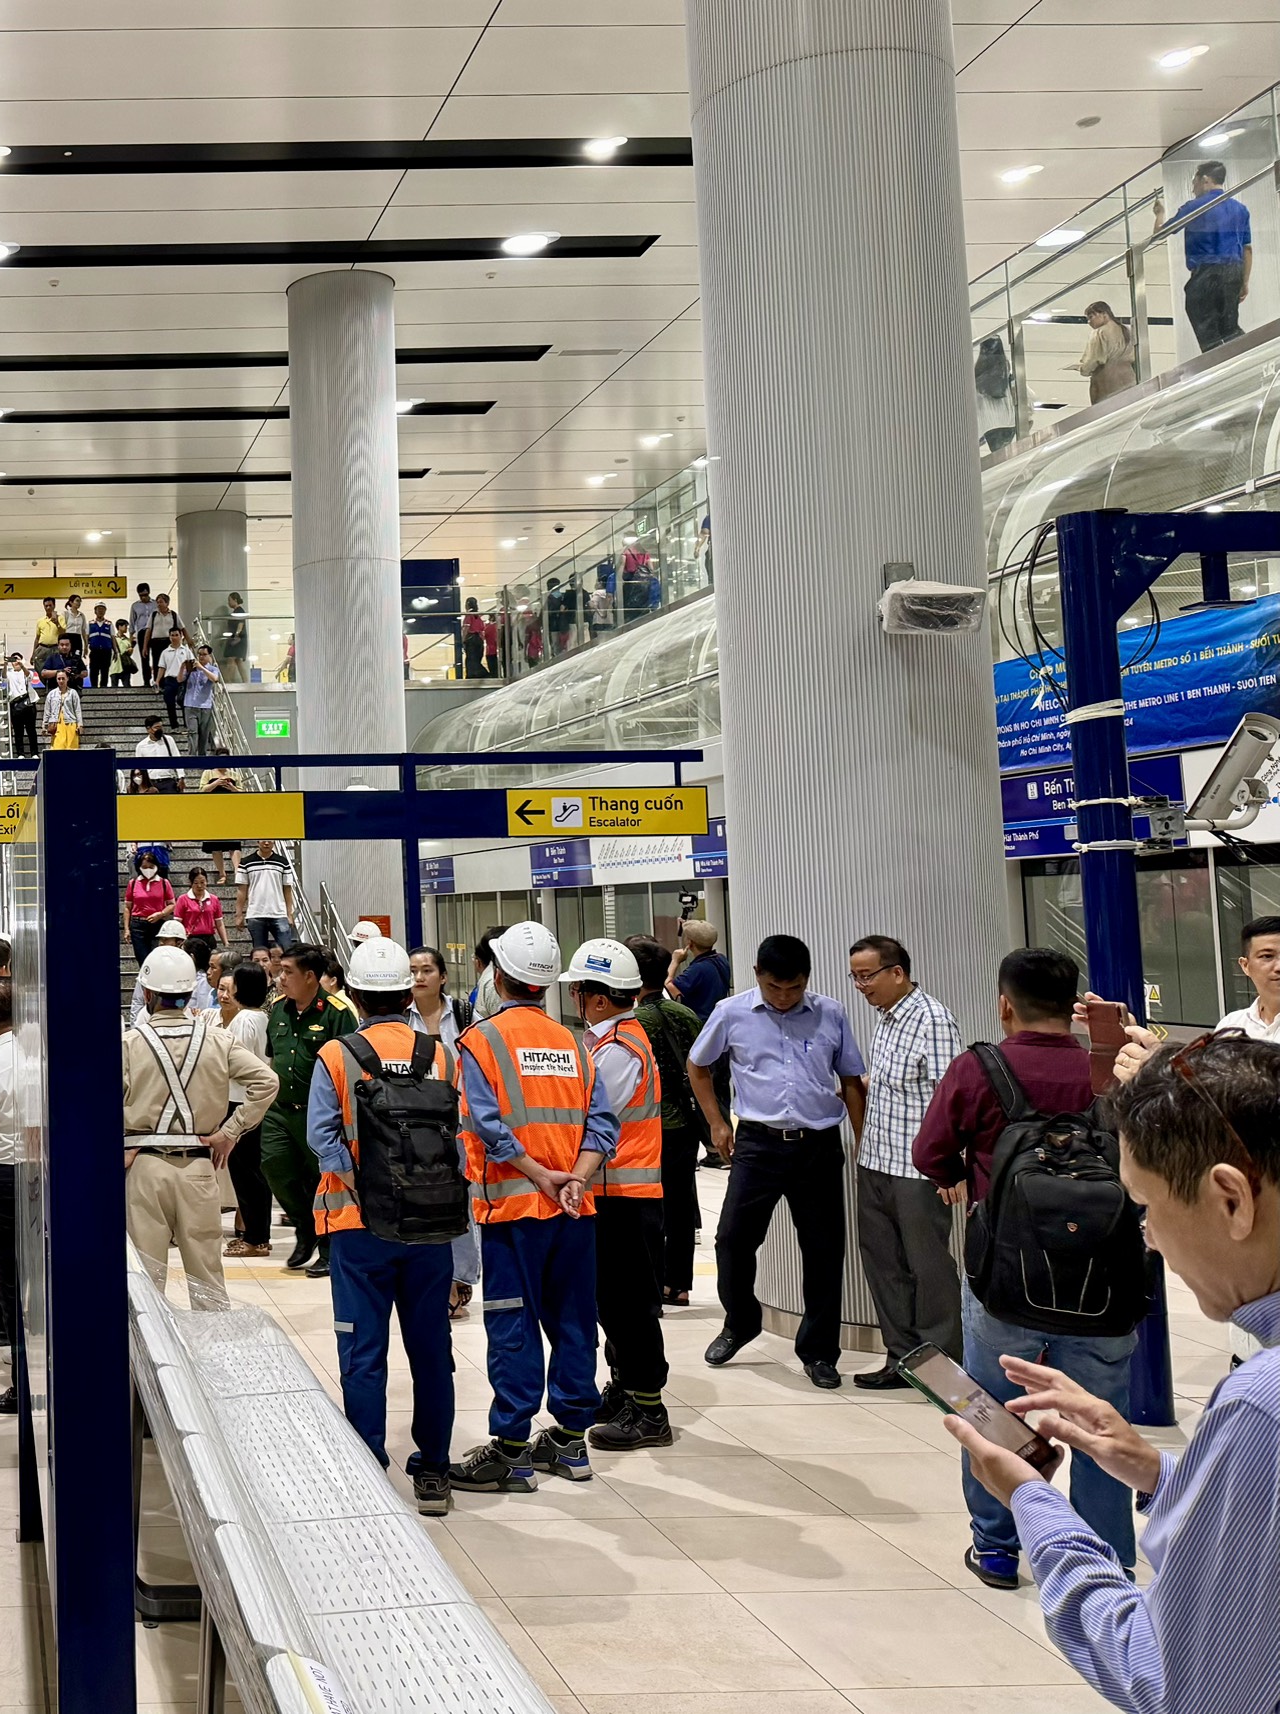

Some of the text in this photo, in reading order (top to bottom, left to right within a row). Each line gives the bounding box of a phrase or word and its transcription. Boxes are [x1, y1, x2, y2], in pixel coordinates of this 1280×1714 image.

[1154, 656, 1178, 670] METRO
[1193, 652, 1197, 662] 1
[1200, 645, 1214, 660] BẾN
[1216, 641, 1244, 656] THÀNH
[1139, 696, 1162, 708] METRO
[1165, 692, 1179, 704] LINE
[1187, 688, 1202, 700] BEN
[1204, 682, 1231, 696] THANH
[1237, 678, 1257, 690] SUOI
[1259, 674, 1277, 686] TIEN
[1013, 722, 1020, 731] IN
[1021, 721, 1030, 730] HO
[1030, 719, 1042, 728] CHI
[1043, 715, 1059, 726] MINH
[1020, 749, 1027, 757] Ho
[1028, 746, 1037, 755] Chi
[1038, 745, 1051, 754] Minh
[1043, 778, 1062, 795] Bến
[589, 794, 684, 814] Thang cuốn
[1052, 800, 1066, 810] Ben
[589, 817, 642, 827] Escalator
[529, 961, 554, 970] HITACHI
[523, 1052, 570, 1063] HITACHI
[521, 1064, 545, 1072] Inspire
[557, 1065, 574, 1073] Next
[310, 1665, 327, 1684] NOT
